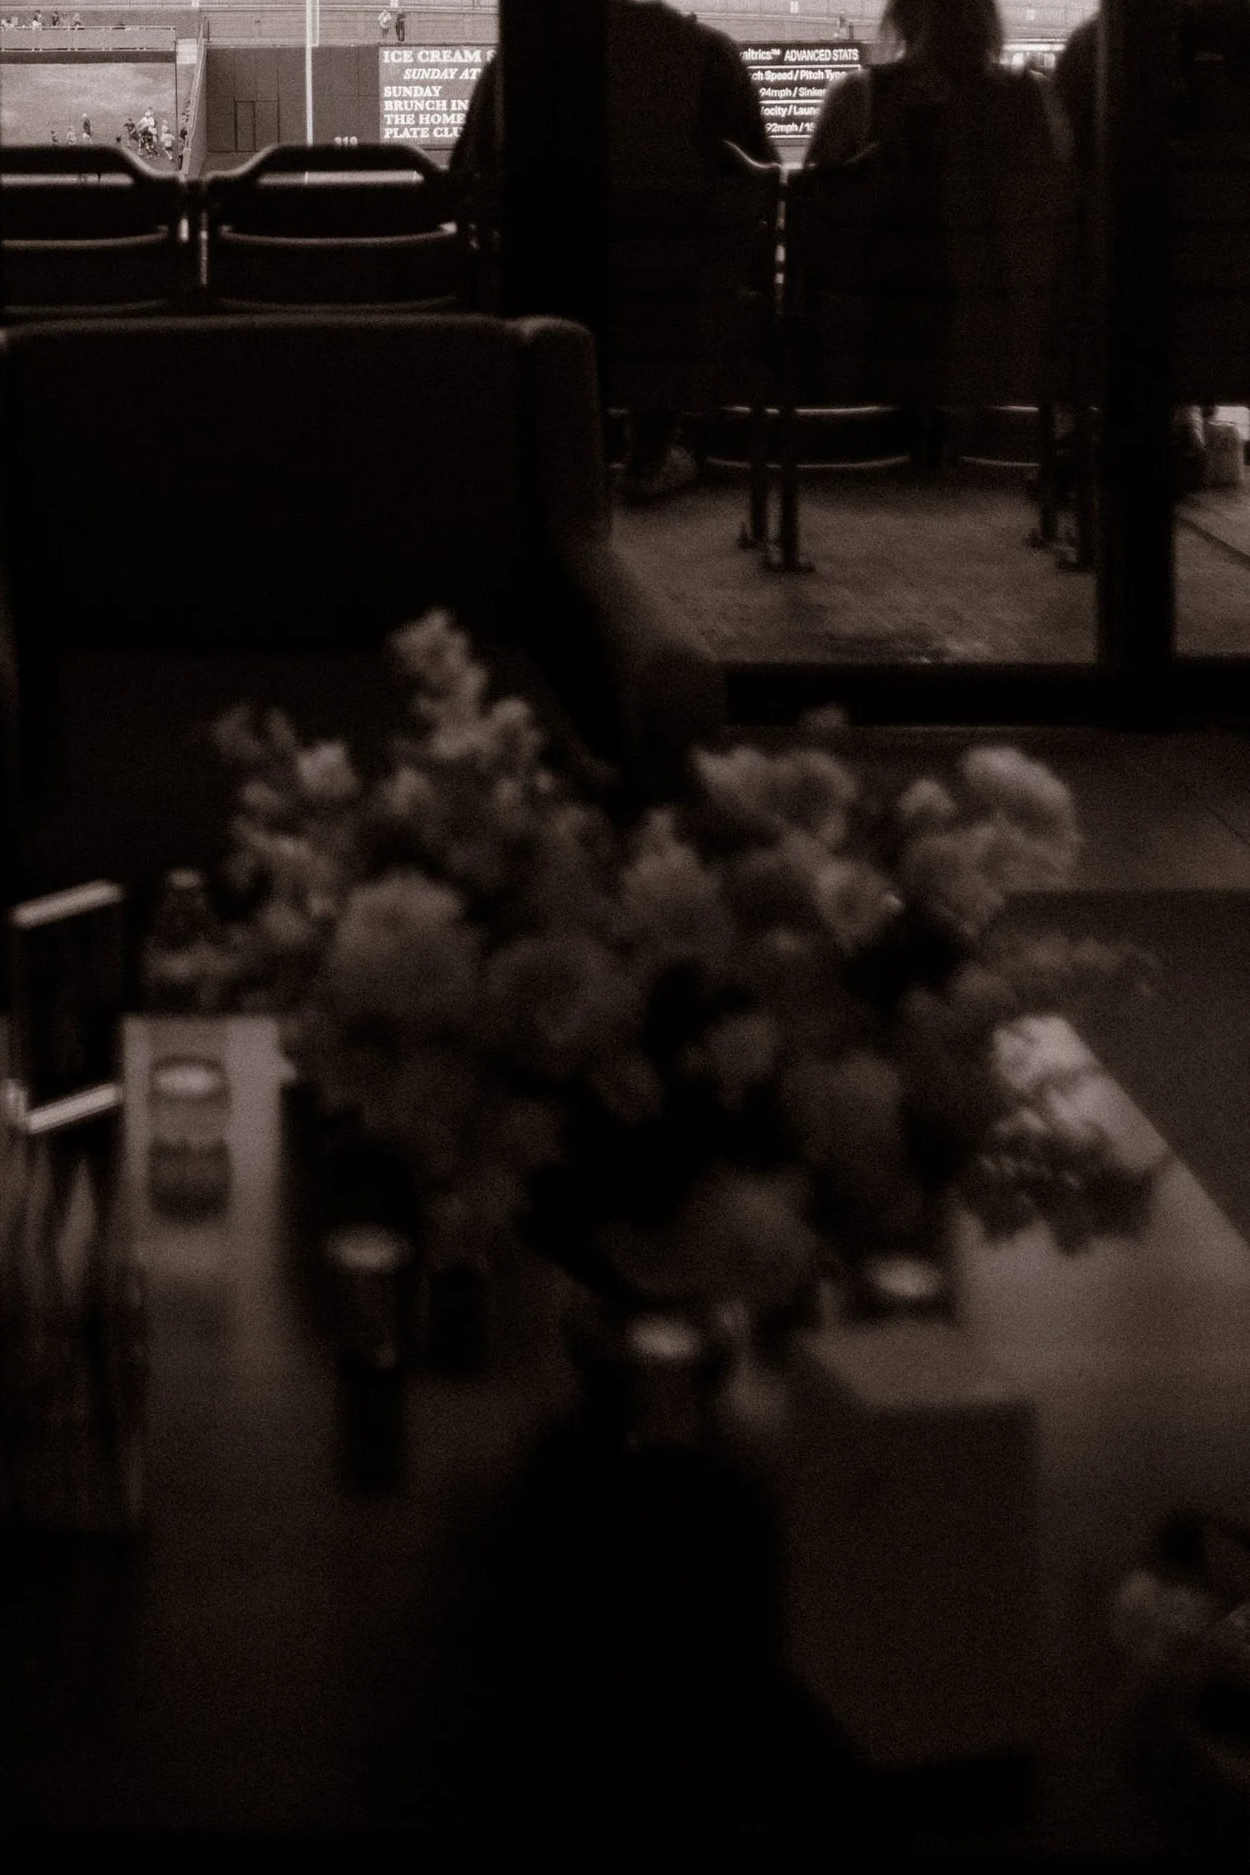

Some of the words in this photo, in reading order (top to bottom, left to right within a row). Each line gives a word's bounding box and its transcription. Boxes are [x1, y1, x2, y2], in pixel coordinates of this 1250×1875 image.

[383, 50, 413, 63] ICE
[417, 50, 482, 63] CREAM
[784, 48, 831, 62] ADVANCED
[832, 48, 860, 61] STATS
[403, 68, 459, 80] SUNDAY
[765, 69, 793, 82] Speed
[794, 70, 800, 81] /
[800, 69, 824, 80] Pitch
[384, 86, 442, 97] SUNDAY
[759, 87, 792, 99] 94mph
[792, 87, 798, 98] /
[384, 99, 447, 111] BRUNCH
[450, 99, 470, 111] IN
[788, 105, 793, 116] /
[384, 113, 415, 125] THE
[419, 113, 467, 125] HOME
[384, 127, 430, 139] PLATE
[433, 126, 463, 139] CLU
[765, 122, 798, 134] 92mph
[799, 122, 804, 133] /
